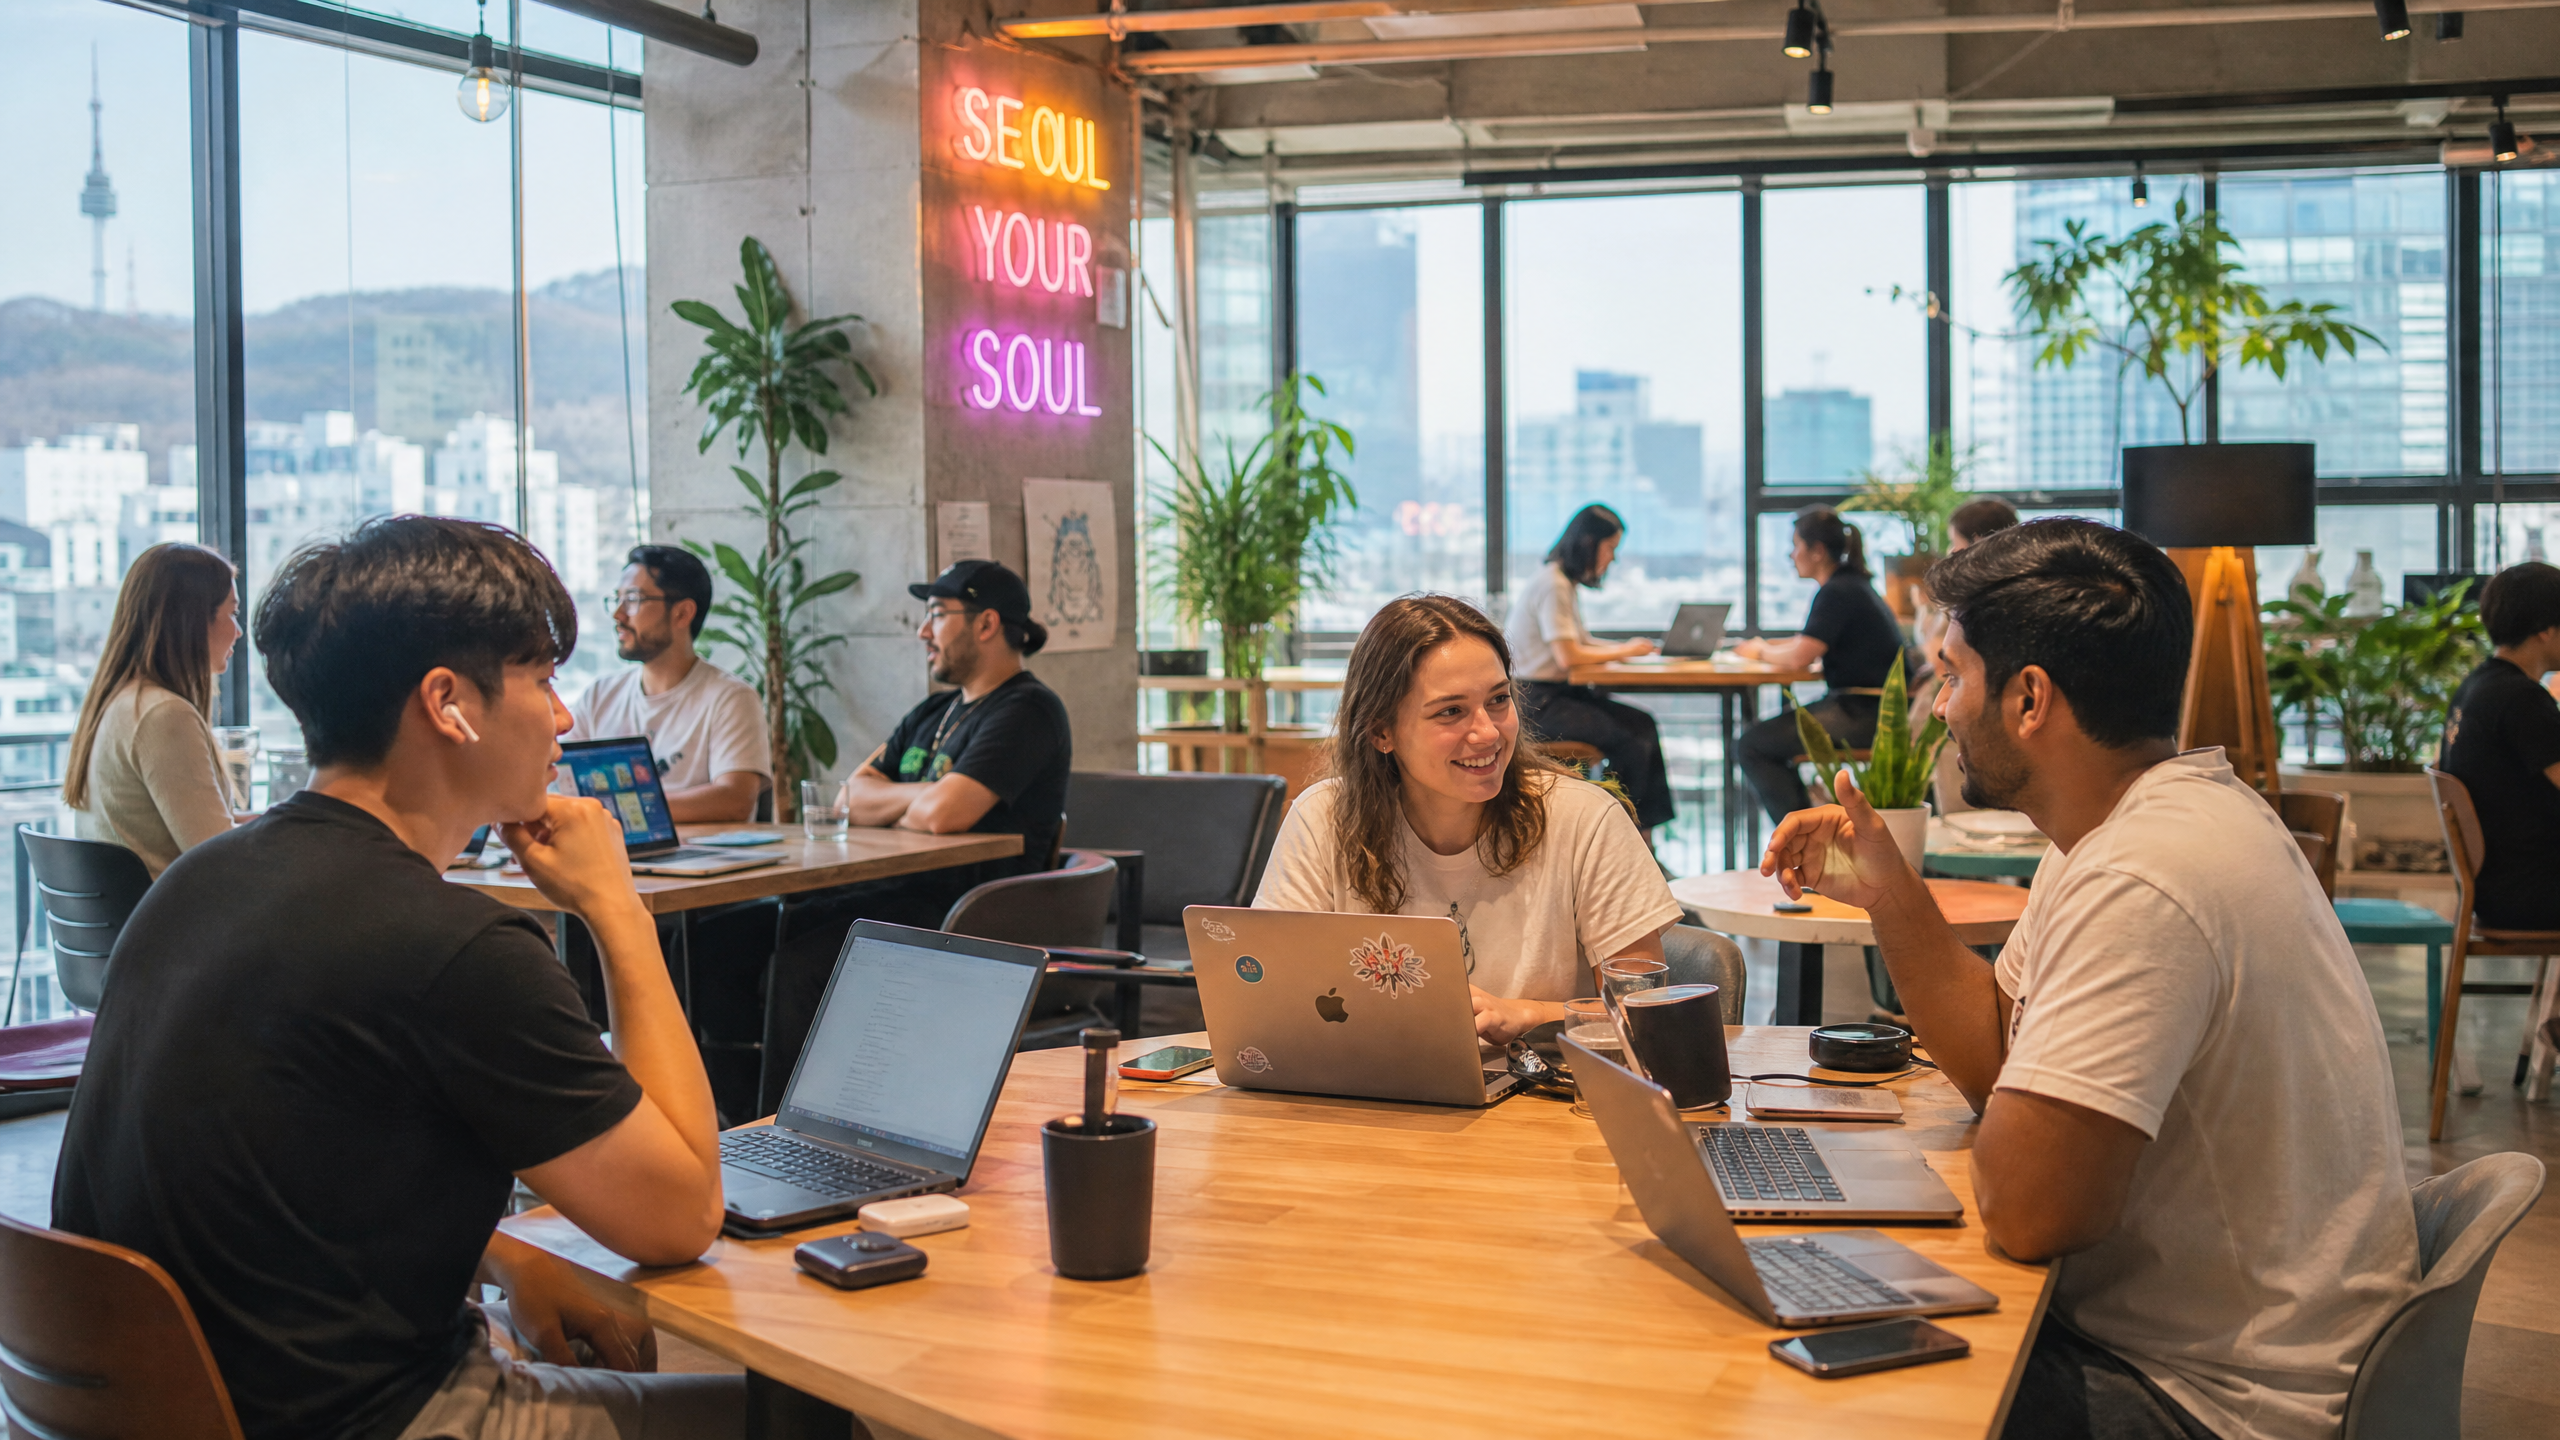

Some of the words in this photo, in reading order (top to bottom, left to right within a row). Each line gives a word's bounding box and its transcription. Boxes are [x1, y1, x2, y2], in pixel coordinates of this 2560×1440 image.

[963, 87, 1111, 190] SEOUL
[974, 205, 1094, 298] YOUR
[972, 329, 1102, 417] SOUL
